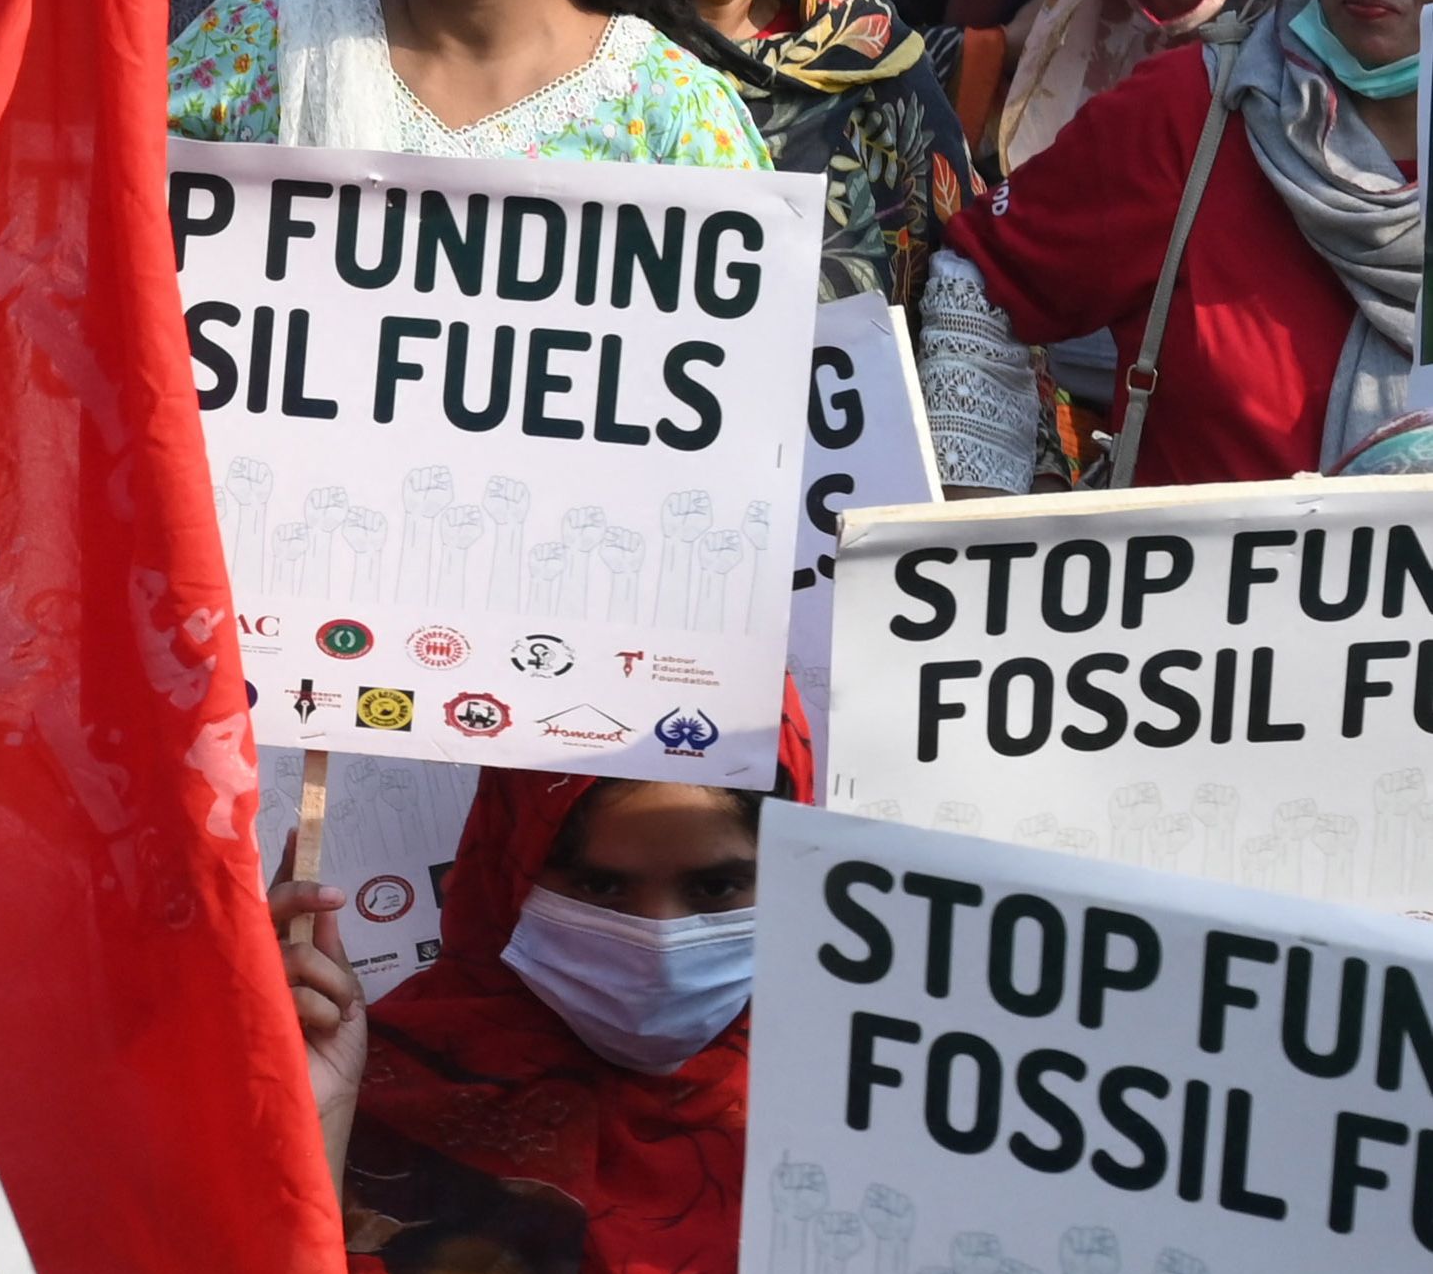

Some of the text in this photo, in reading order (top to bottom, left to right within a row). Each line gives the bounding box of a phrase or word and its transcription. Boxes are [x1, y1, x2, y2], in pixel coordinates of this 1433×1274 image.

[264, 177, 765, 320] FUNDING
[372, 314, 728, 452] FUELS
[889, 535, 1195, 643] STOP
[651, 672, 721, 687] Foundation
[917, 646, 1306, 763] FOSSIL
[817, 860, 1163, 1029] STOP
[846, 1011, 1288, 1222] FOSSIL
